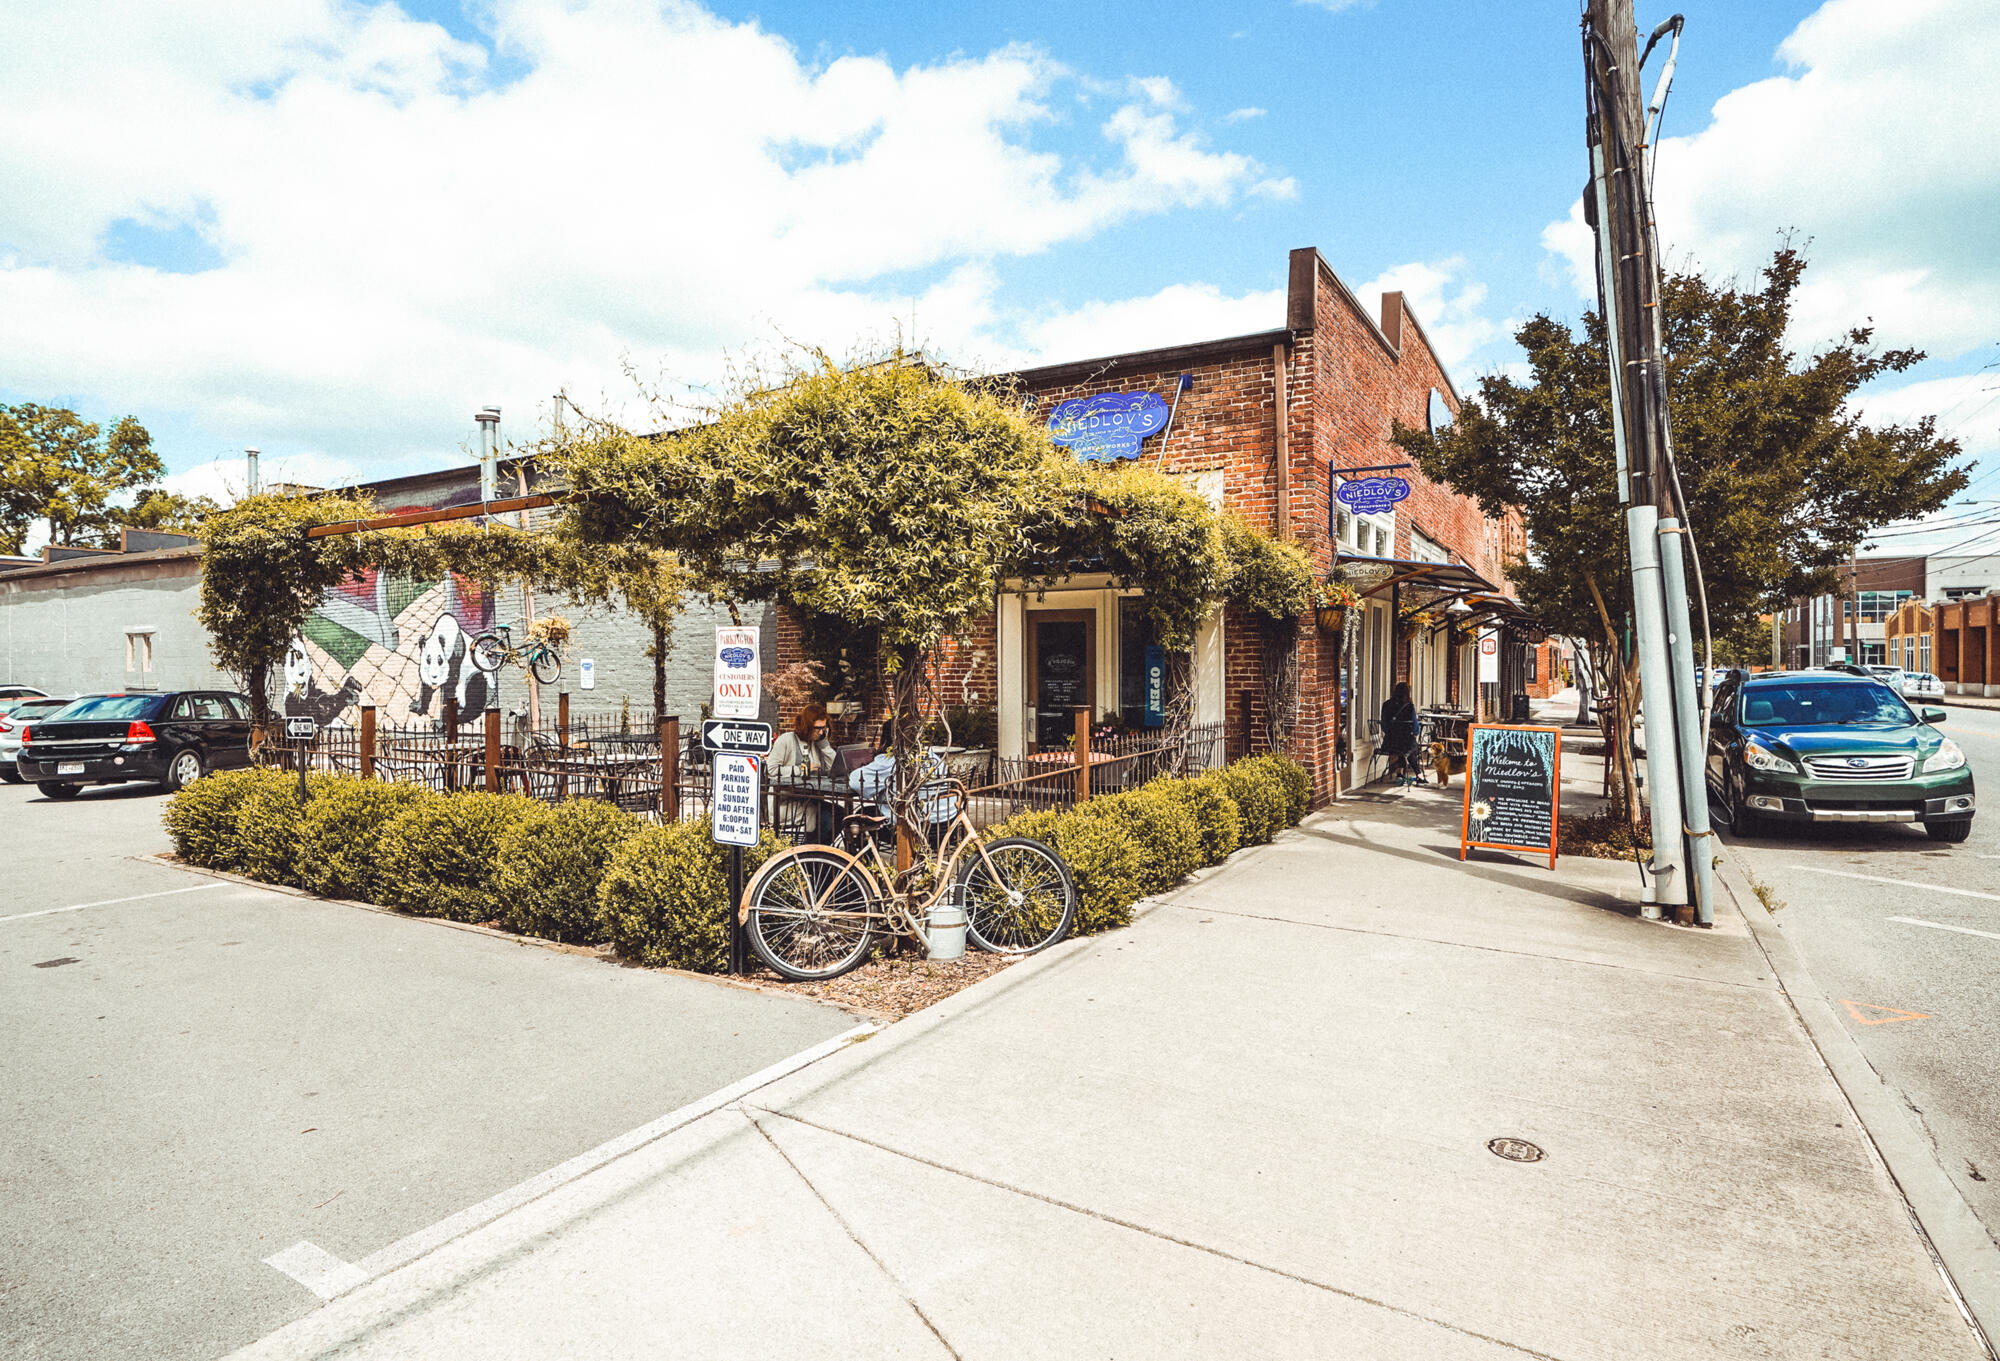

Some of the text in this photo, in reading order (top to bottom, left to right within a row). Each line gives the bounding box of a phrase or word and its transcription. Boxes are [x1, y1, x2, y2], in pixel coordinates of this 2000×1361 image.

[1060, 413, 1153, 433] NIEDLOV'S
[1345, 488, 1402, 500] NIEDLOV'S
[720, 634, 744, 645] PARKING
[719, 683, 754, 697] ONLY
[1150, 666, 1161, 713] OPEN
[723, 730, 765, 744] ONE WAY
[1491, 755, 1537, 767] Welcome to
[729, 764, 745, 773] PAID
[1485, 766, 1542, 777] Niedlov's
[721, 774, 750, 784] PARKING
[723, 784, 750, 794] ALL DAY
[723, 794, 749, 804] SUNDAY
[718, 804, 754, 815] AND AFTER
[723, 814, 749, 824] 6:00PM
[719, 824, 734, 832] MON
[740, 826, 752, 835] SAT
